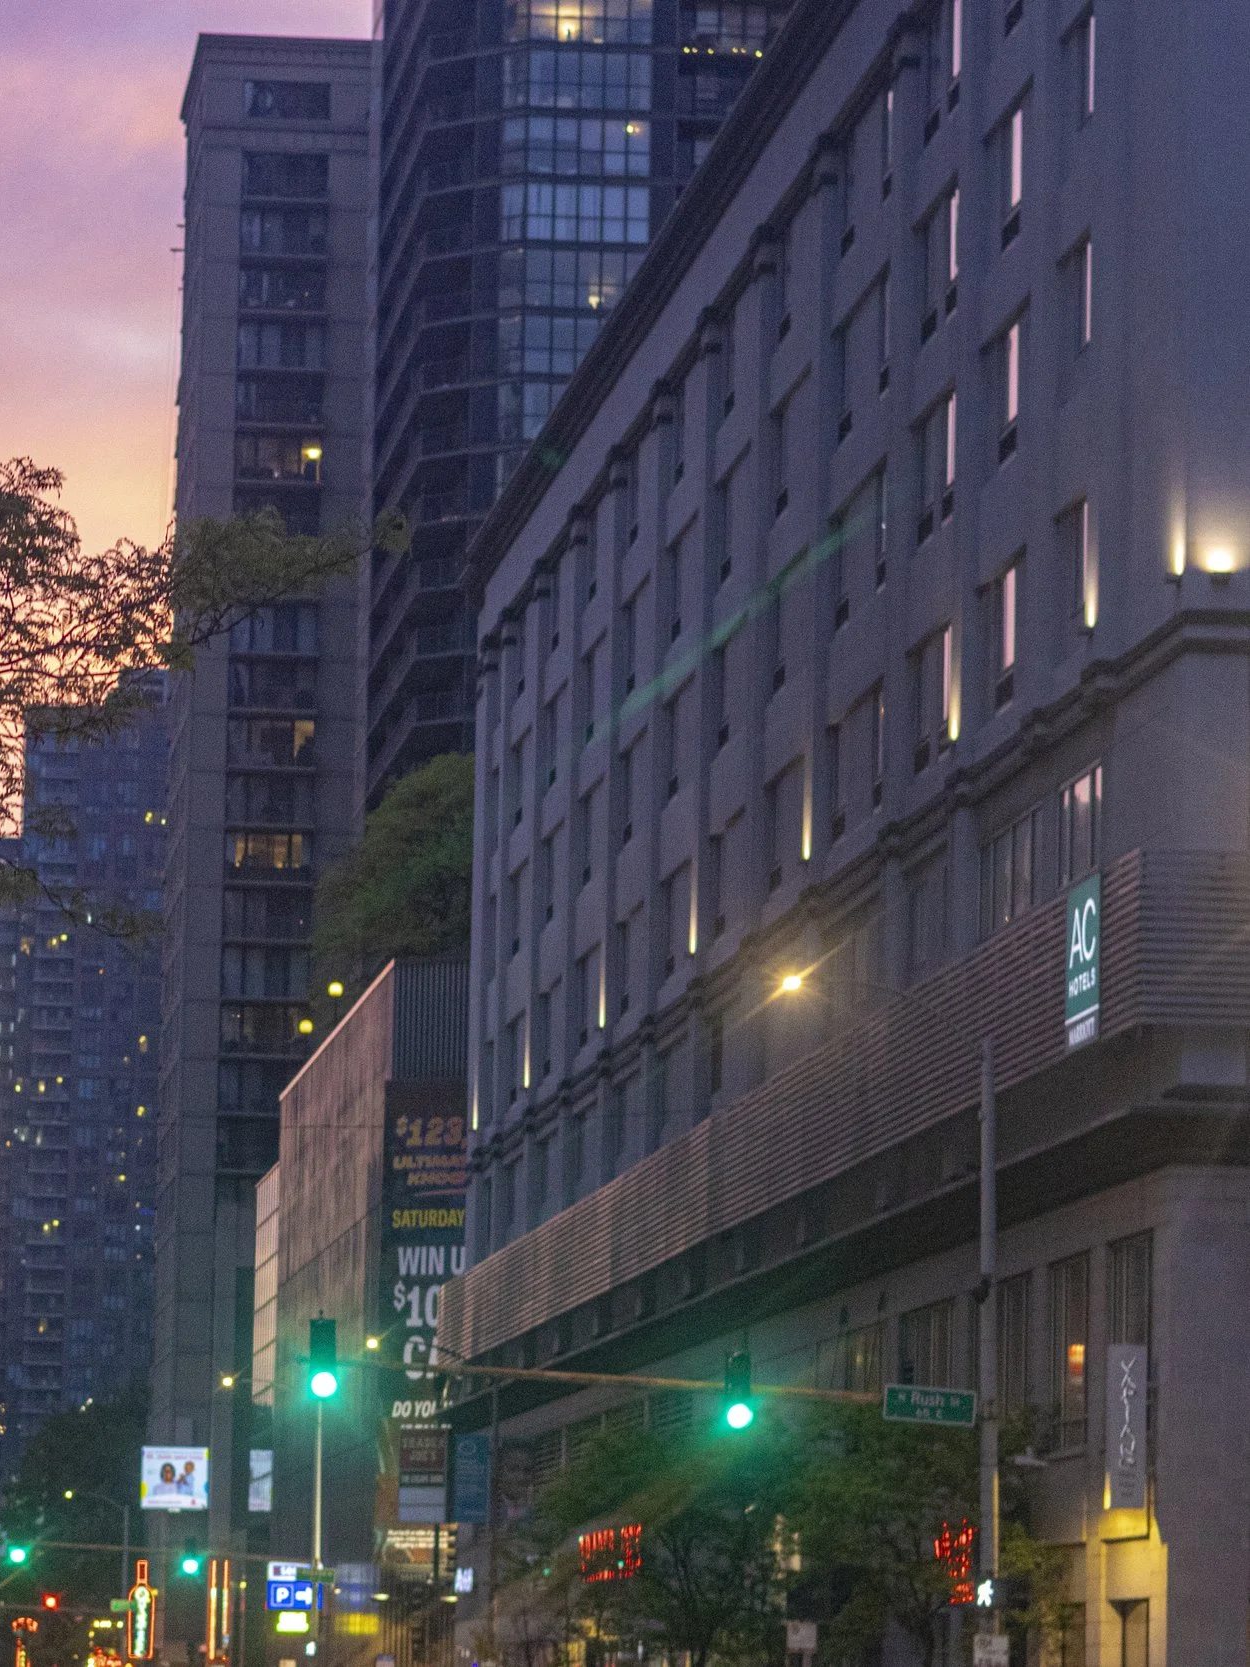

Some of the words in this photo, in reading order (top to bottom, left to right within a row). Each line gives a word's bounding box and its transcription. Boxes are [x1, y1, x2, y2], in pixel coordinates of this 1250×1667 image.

[1069, 898, 1096, 968] AC
[1069, 967, 1096, 998] HOTELS
[391, 1210, 465, 1229] SATURDAY
[398, 1246, 445, 1276] WIN
[392, 1400, 412, 1418] DO
[911, 1390, 945, 1408] Rush
